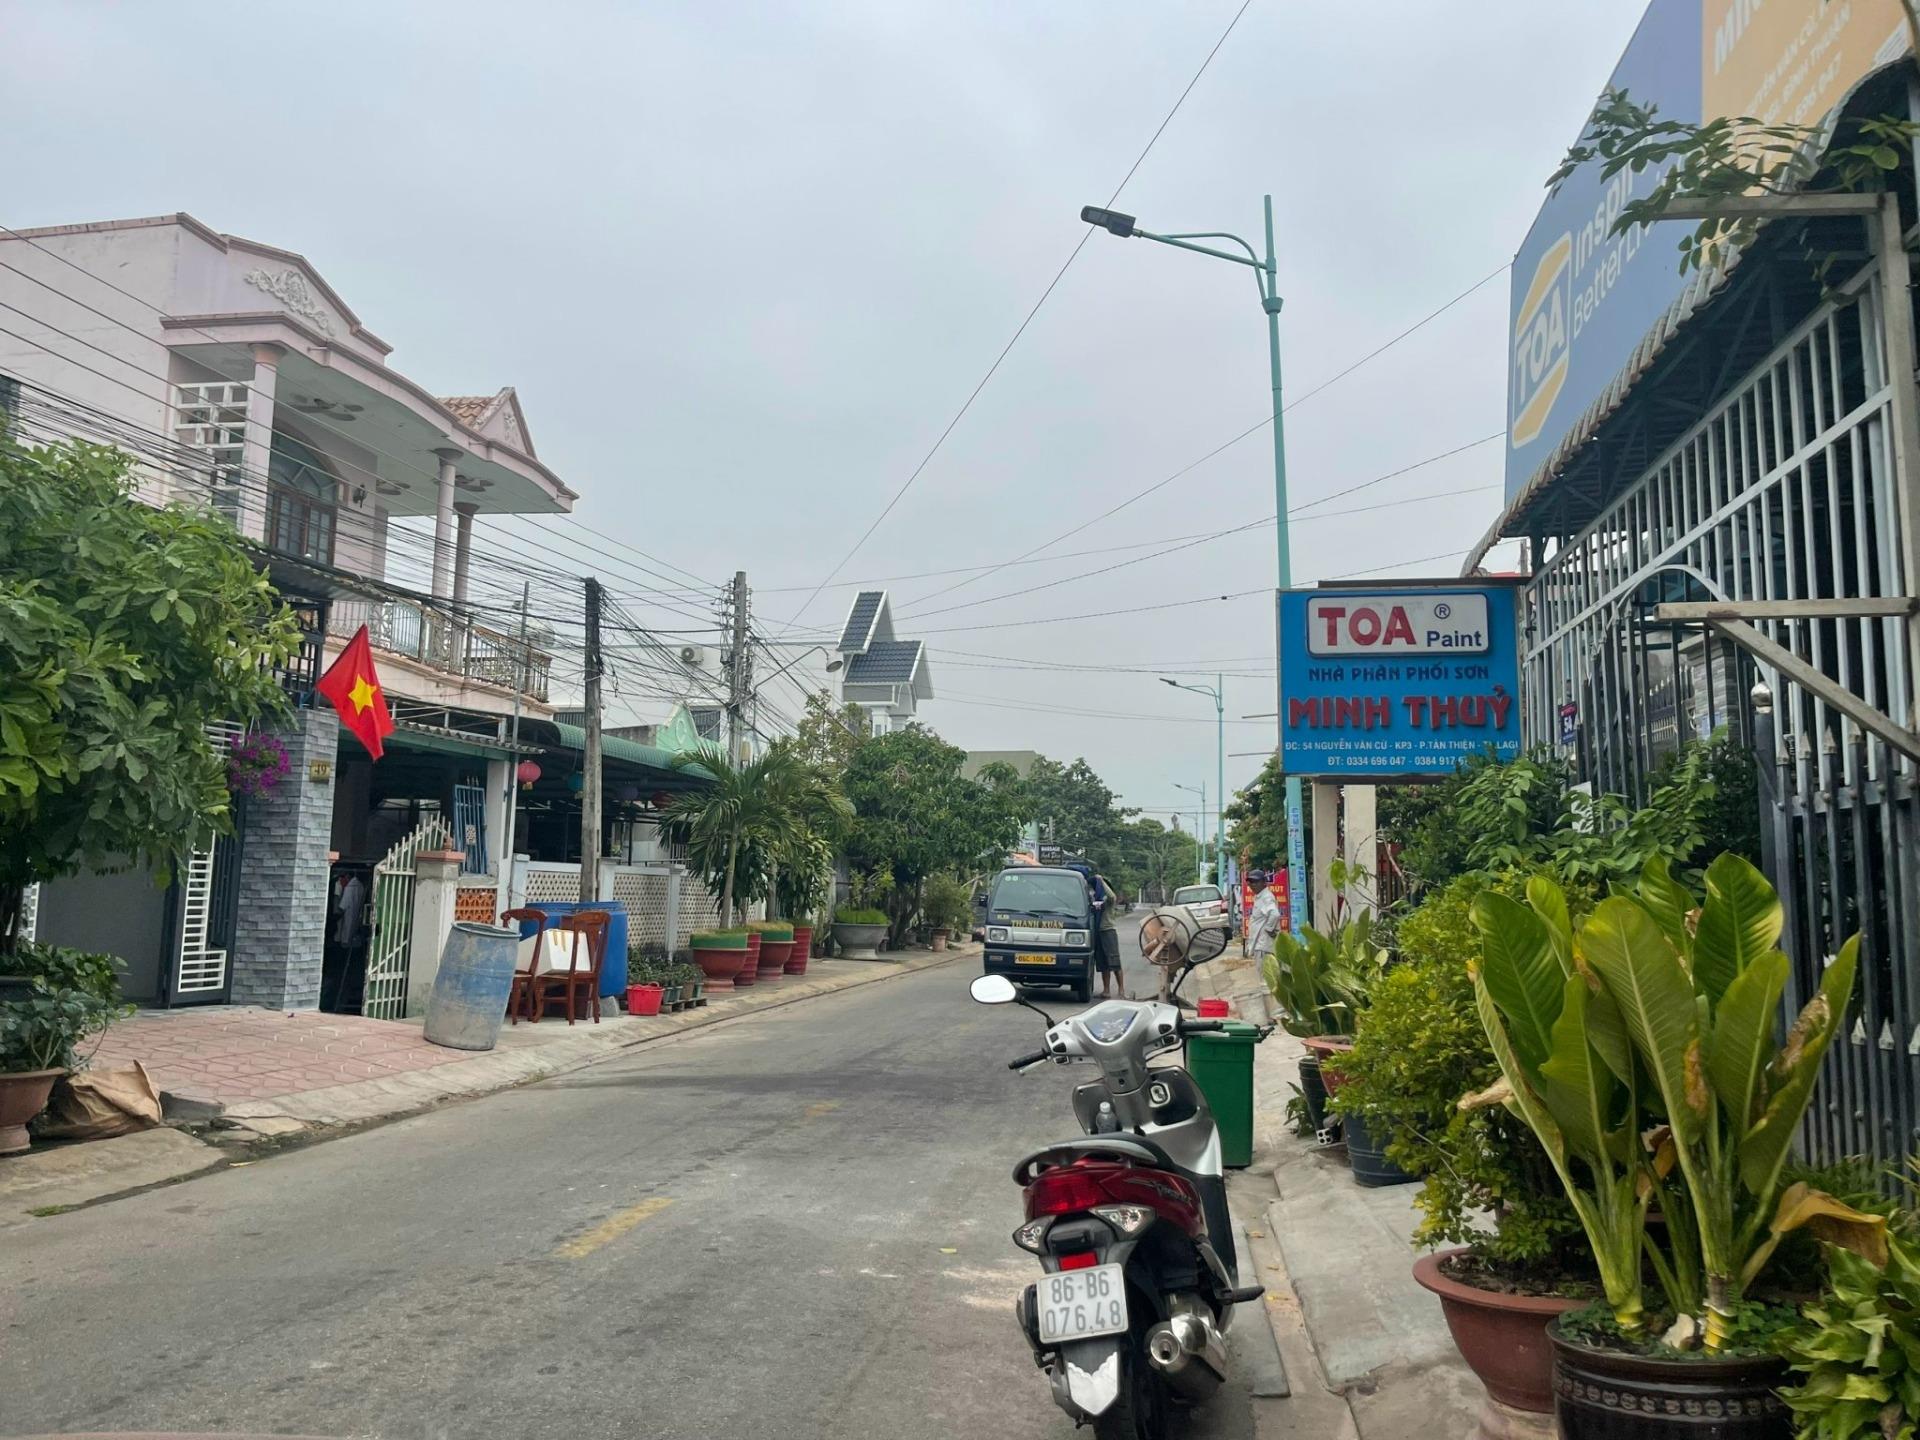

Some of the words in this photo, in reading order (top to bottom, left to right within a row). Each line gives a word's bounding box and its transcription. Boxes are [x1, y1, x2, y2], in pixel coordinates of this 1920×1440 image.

[1574, 246, 1629, 340] Better
[1517, 286, 1565, 403] TOA
[1317, 606, 1417, 647] TOA
[1426, 630, 1483, 648] Paint
[1308, 664, 1345, 682] NHÀ
[1454, 664, 1490, 680] SƠN
[1288, 696, 1391, 729] MINH
[1303, 741, 1313, 750] 54
[1314, 738, 1352, 751] NGUYỄN
[1395, 740, 1413, 750] KP3
[314, 763, 327, 776] 49
[1327, 756, 1345, 766] ĐT:
[1346, 756, 1369, 766] 0334
[1370, 756, 1388, 766] 696
[1389, 756, 1407, 766] 047
[1414, 756, 1437, 766] 0384
[1438, 755, 1457, 766] 917
[1010, 919, 1039, 928] THANH
[1051, 1270, 1110, 1305] 86-B6
[1045, 1299, 1121, 1336] 076.48
